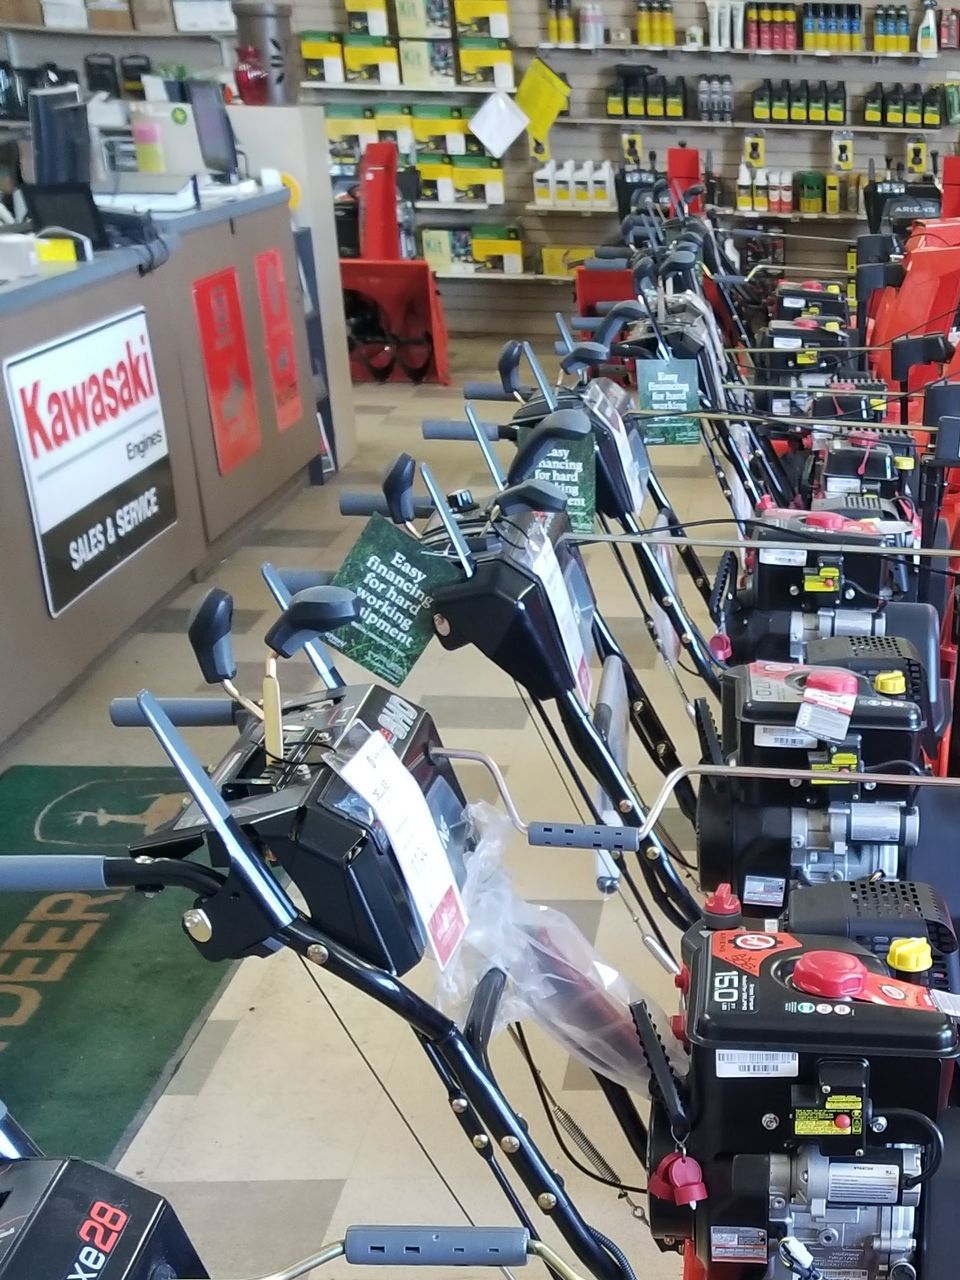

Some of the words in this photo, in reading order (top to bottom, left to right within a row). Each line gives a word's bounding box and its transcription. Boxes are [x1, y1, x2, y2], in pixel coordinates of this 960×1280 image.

[19, 334, 155, 460] Kawasaki
[126, 428, 163, 461] Engines
[546, 448, 570, 460] asy
[534, 469, 551, 481] for
[552, 469, 579, 482] hard
[69, 522, 106, 572] SALES
[105, 520, 116, 546] &
[115, 486, 160, 539] SERVICE
[365, 555, 434, 609] financing
[390, 551, 428, 584] Easy
[356, 587, 414, 632] working
[362, 572, 388, 594] for
[385, 586, 422, 616] hard
[78, 1200, 129, 1254] 28
